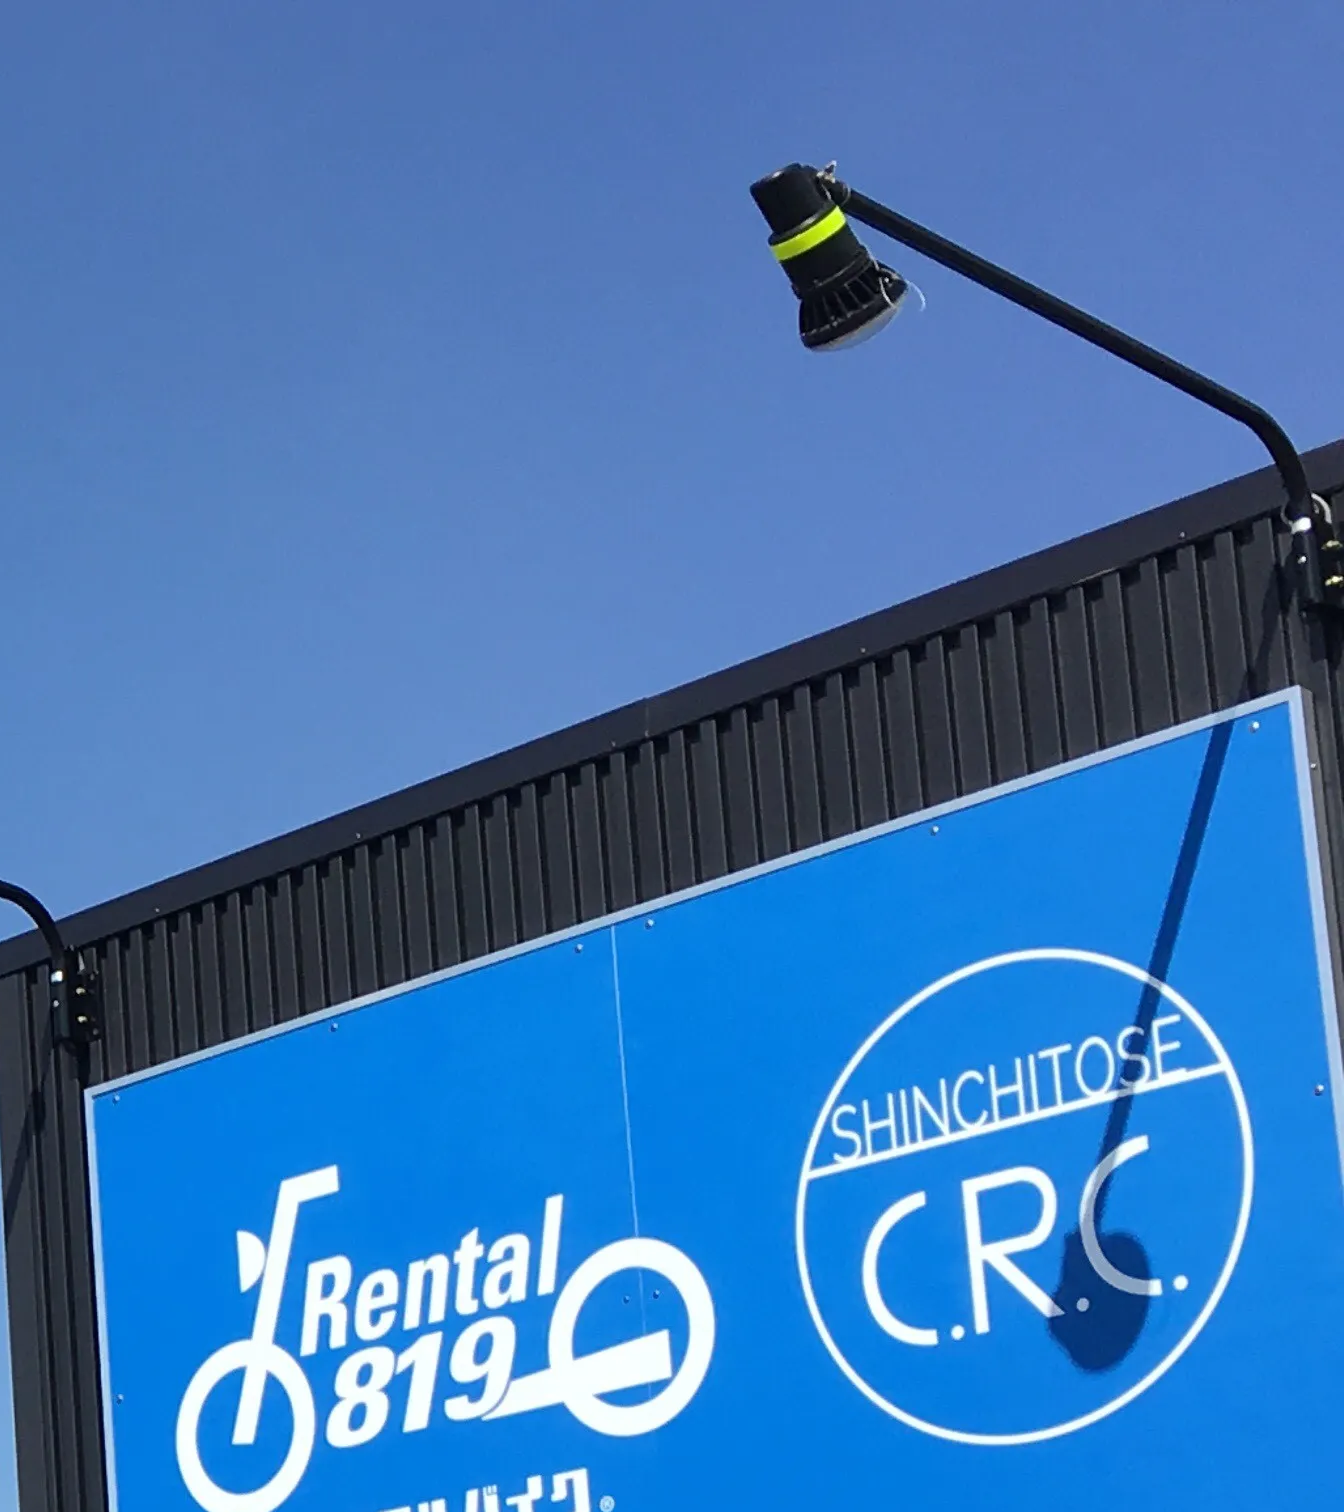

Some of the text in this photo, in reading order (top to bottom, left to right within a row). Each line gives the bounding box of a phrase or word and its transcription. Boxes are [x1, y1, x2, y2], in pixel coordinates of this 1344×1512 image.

[831, 1014, 1188, 1165] SHINCHITOSE
[300, 1193, 564, 1357] Rental
[862, 1134, 1189, 1346] C.R.C.
[324, 1316, 516, 1449] 819
